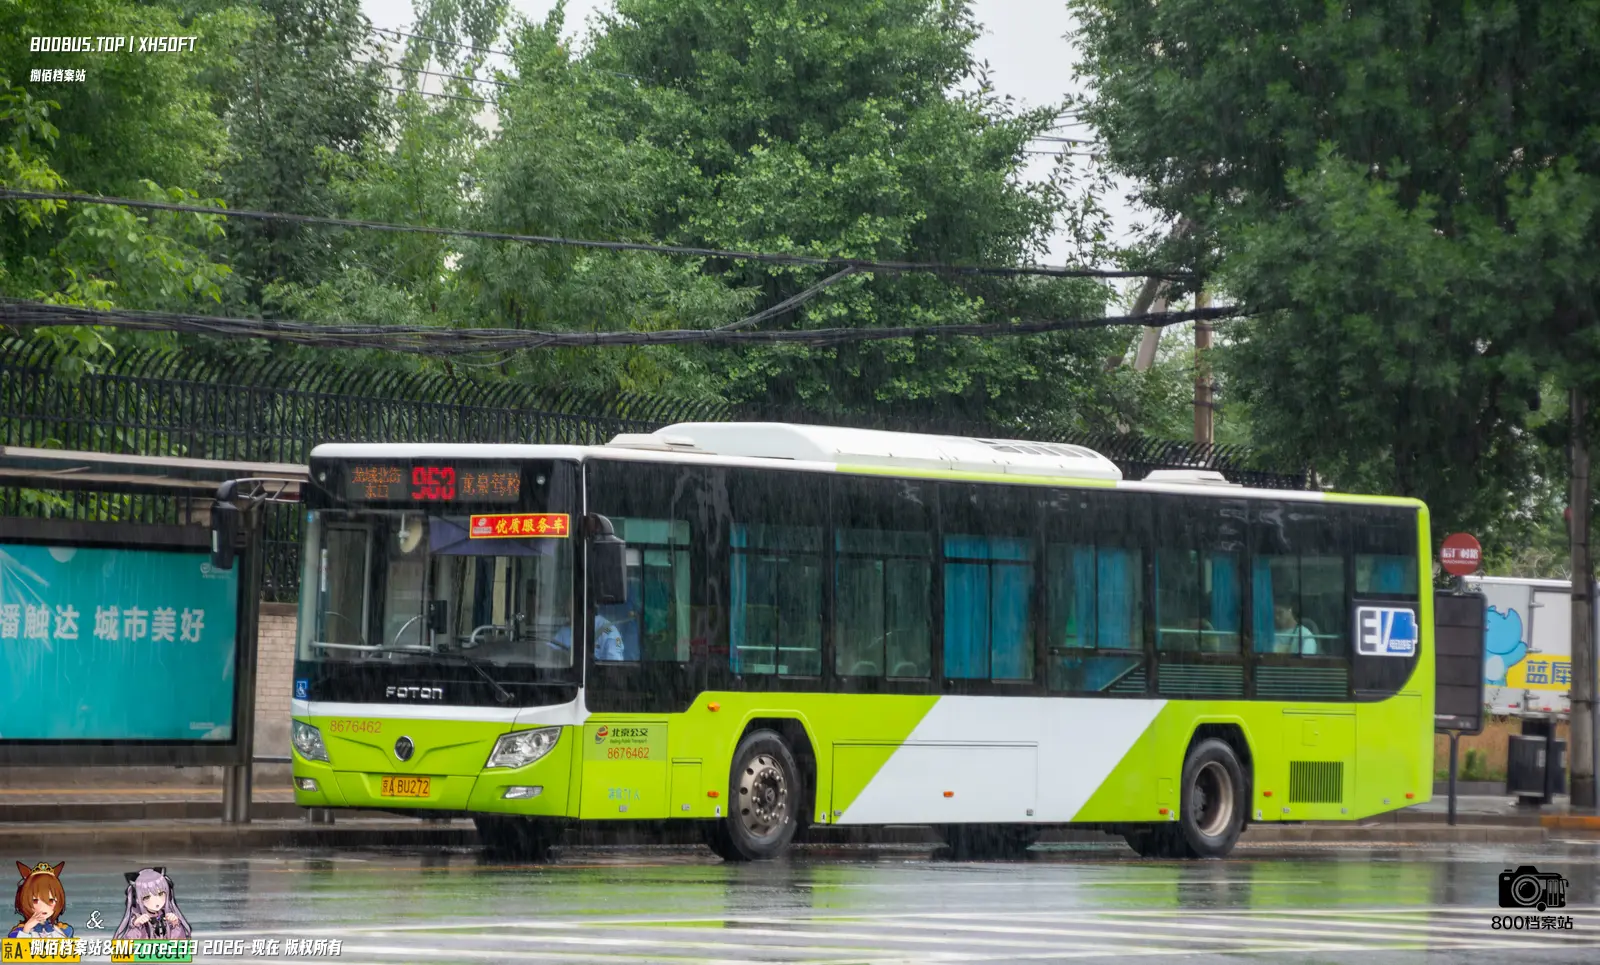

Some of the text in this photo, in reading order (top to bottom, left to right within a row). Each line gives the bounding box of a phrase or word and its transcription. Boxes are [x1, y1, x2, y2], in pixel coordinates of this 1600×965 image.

[412, 466, 456, 500] 953
[495, 517, 565, 535] 优质服务车
[93, 605, 205, 643] 城市美好
[386, 686, 443, 699] FOTON
[330, 720, 382, 733] 8676462
[611, 728, 649, 737] 北京公交
[607, 747, 650, 759] 8676462
